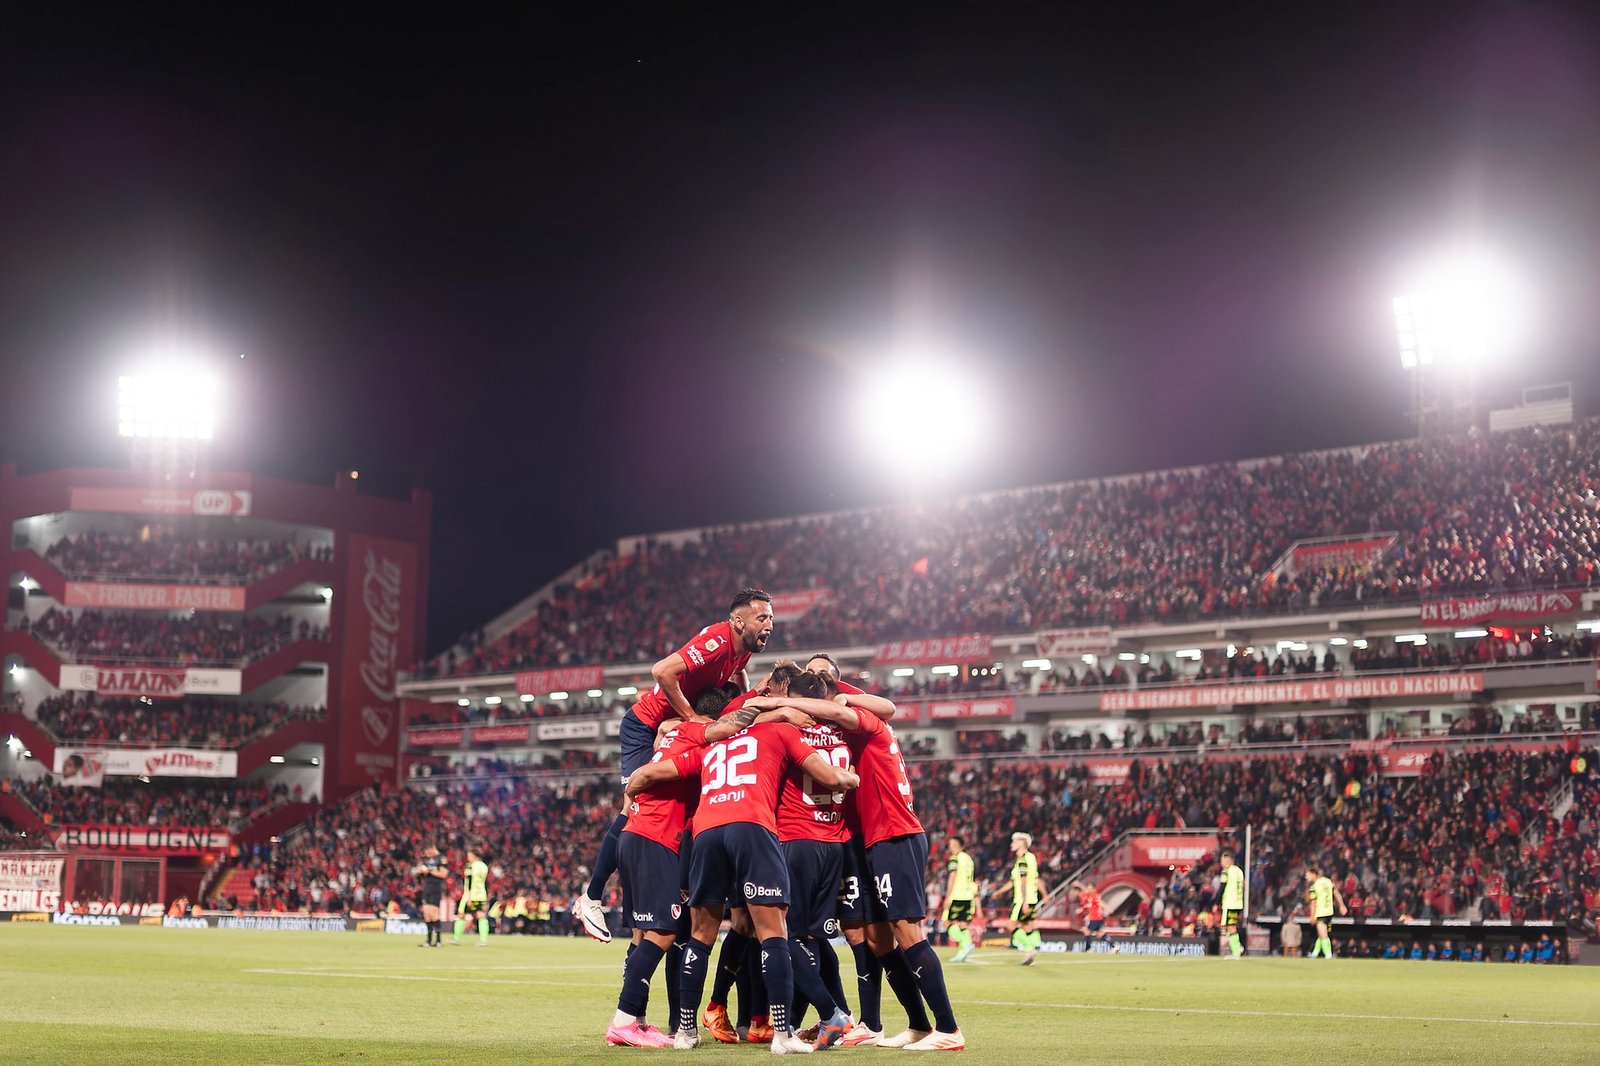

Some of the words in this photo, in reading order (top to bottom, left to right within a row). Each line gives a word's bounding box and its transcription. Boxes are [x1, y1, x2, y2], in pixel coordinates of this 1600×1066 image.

[1138, 690, 1192, 707] SIEMPRE
[1312, 683, 1328, 698] EL
[1335, 680, 1398, 697] ORGULLO
[1404, 676, 1478, 693] NACIONAL
[701, 736, 758, 795] 32
[758, 886, 782, 897] Bank
